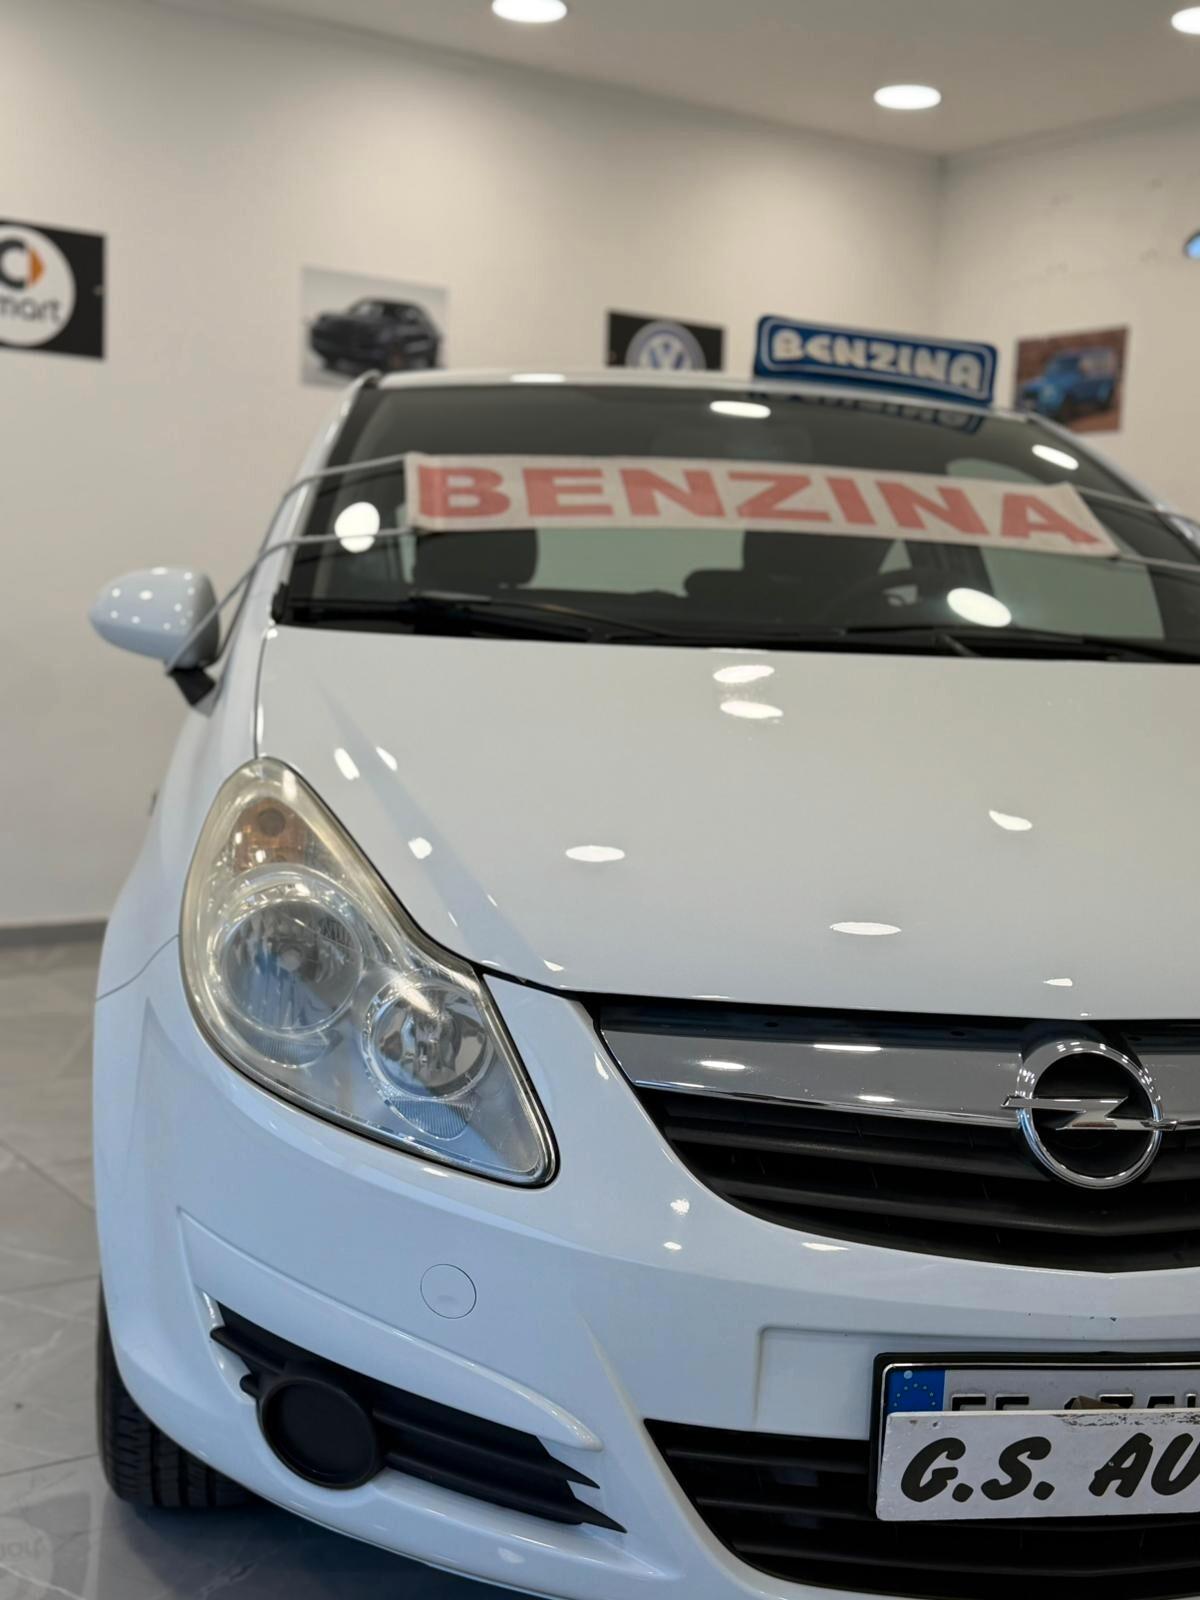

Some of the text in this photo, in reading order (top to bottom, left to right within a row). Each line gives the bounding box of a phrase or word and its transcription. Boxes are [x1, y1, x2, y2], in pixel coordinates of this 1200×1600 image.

[771, 327, 983, 392] BENZINA
[418, 464, 1096, 546] BENZINA
[901, 1432, 1200, 1503] G.S. AU
